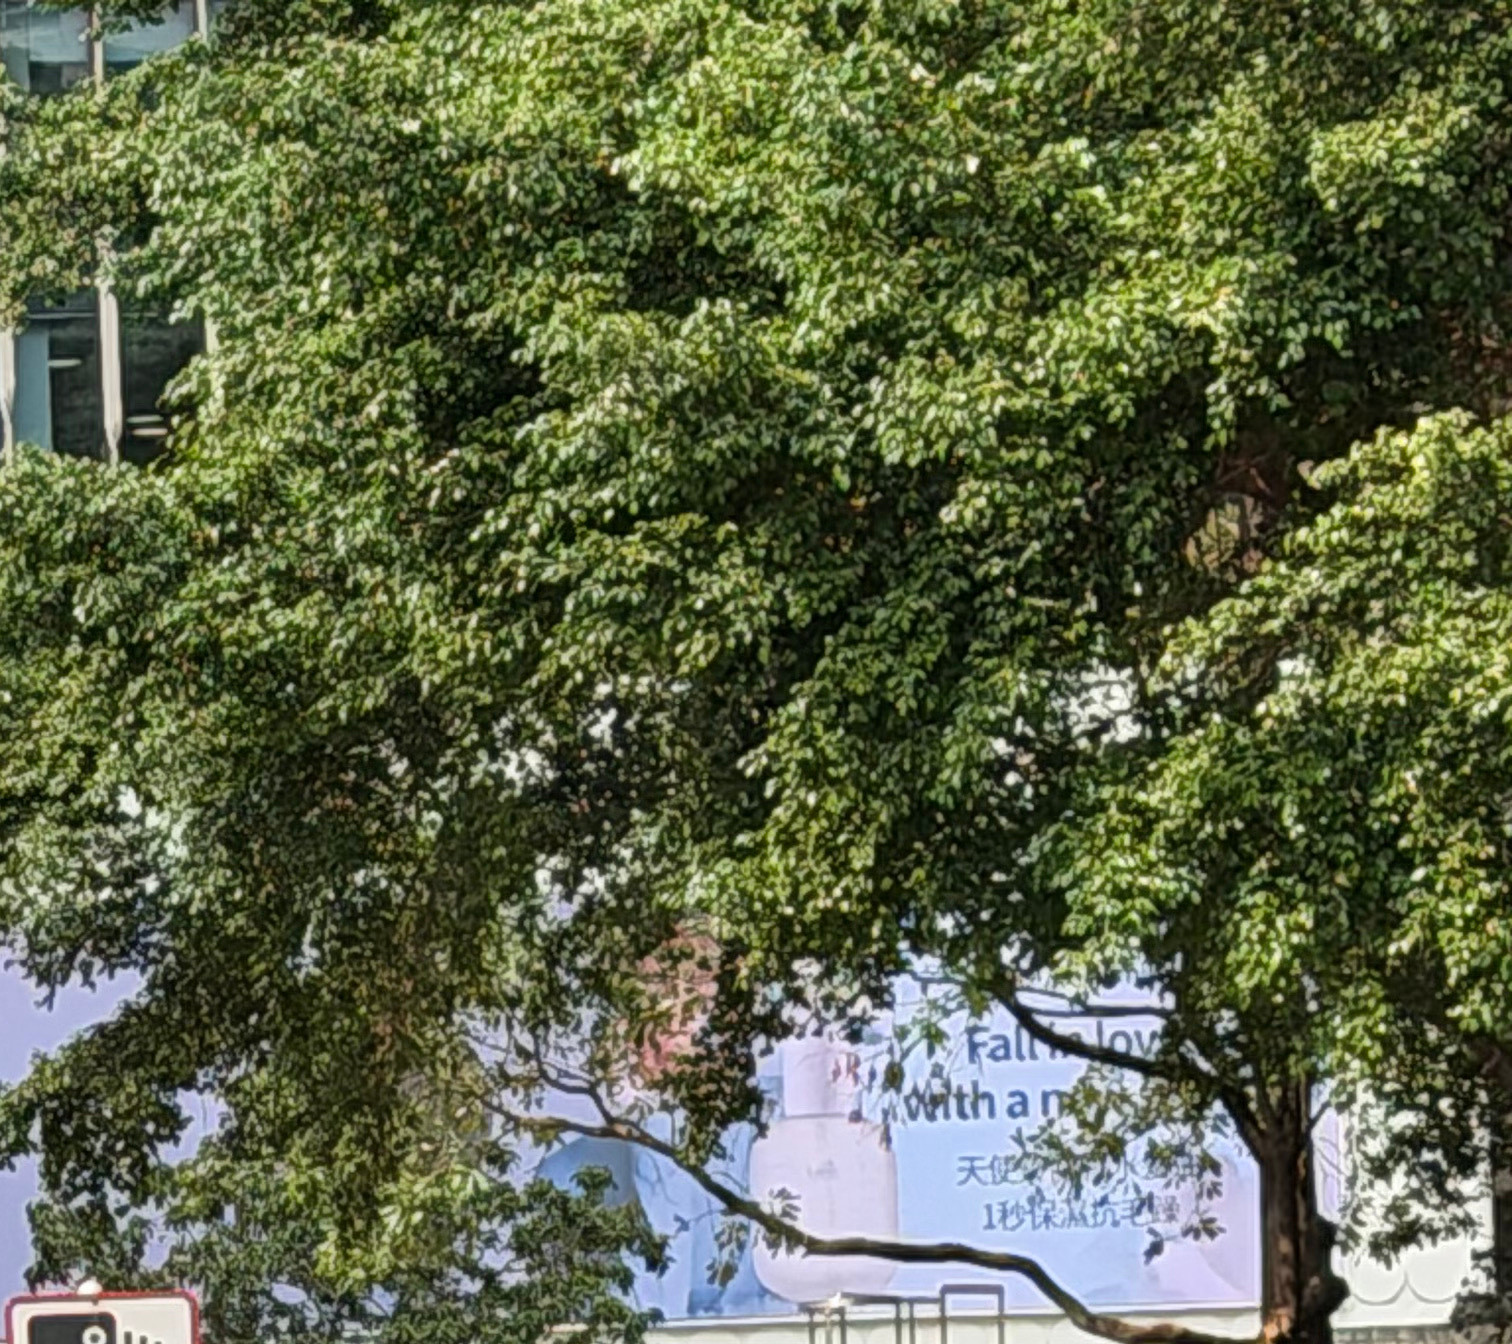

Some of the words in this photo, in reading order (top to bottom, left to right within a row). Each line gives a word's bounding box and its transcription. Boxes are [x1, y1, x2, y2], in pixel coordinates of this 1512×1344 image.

[968, 1022, 1039, 1064] Fall
[1096, 1020, 1161, 1053] lov
[903, 1079, 996, 1122] with
[1007, 1089, 1030, 1118] a
